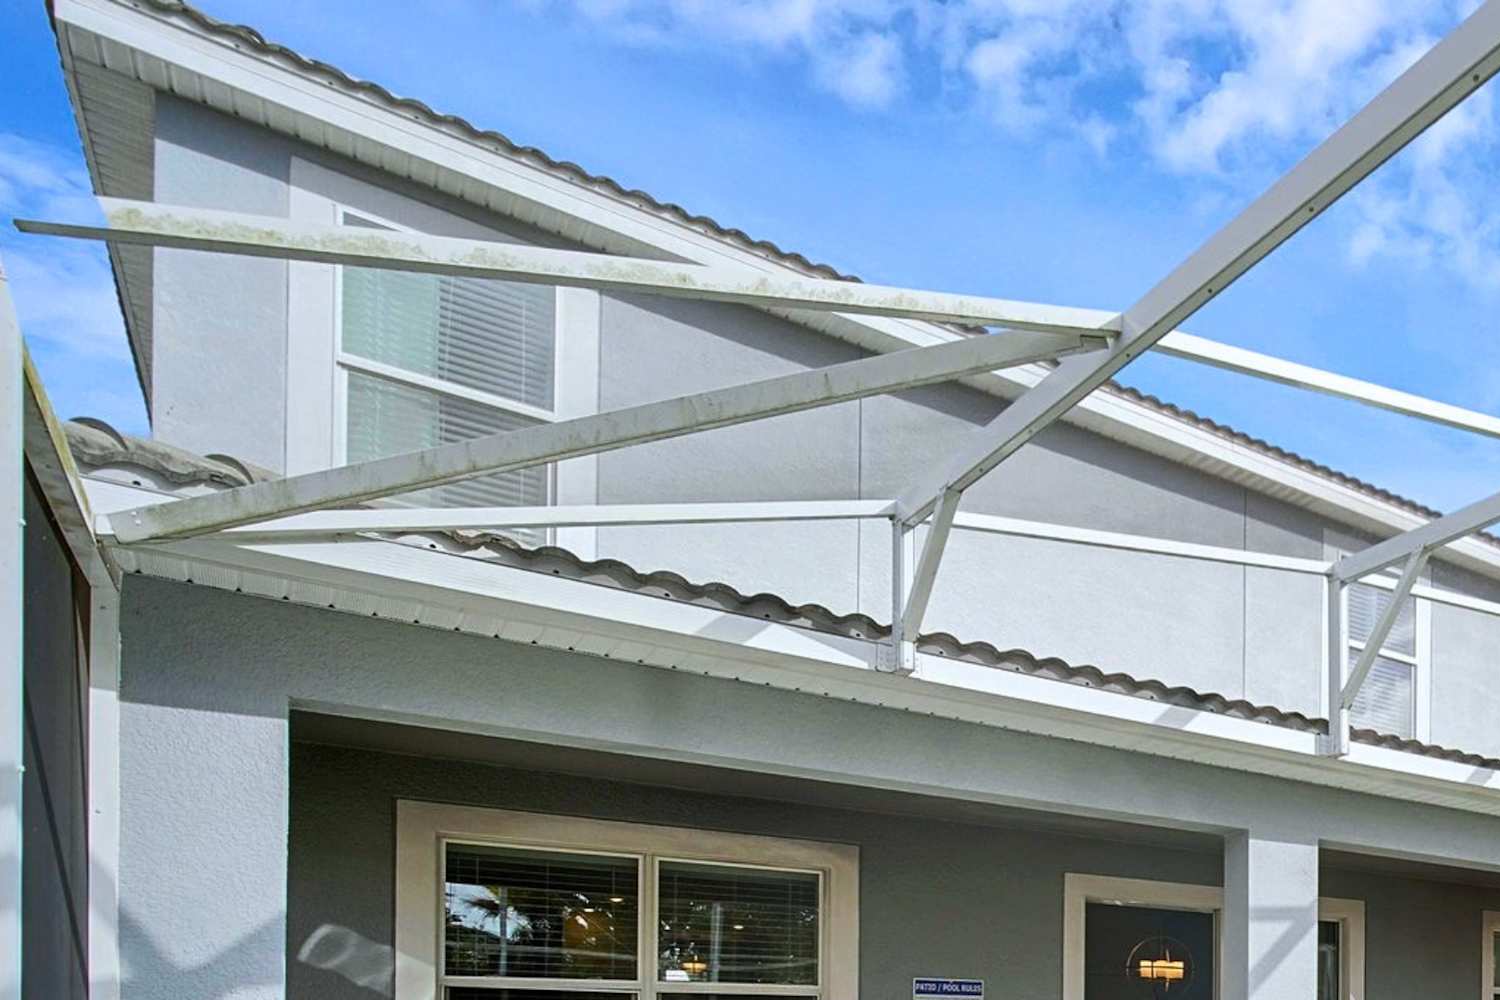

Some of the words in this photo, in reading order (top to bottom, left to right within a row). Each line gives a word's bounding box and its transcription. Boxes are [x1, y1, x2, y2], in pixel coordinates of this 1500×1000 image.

[916, 983, 937, 992] PATIO
[943, 983, 960, 992] POOL
[961, 984, 982, 993] RULES
